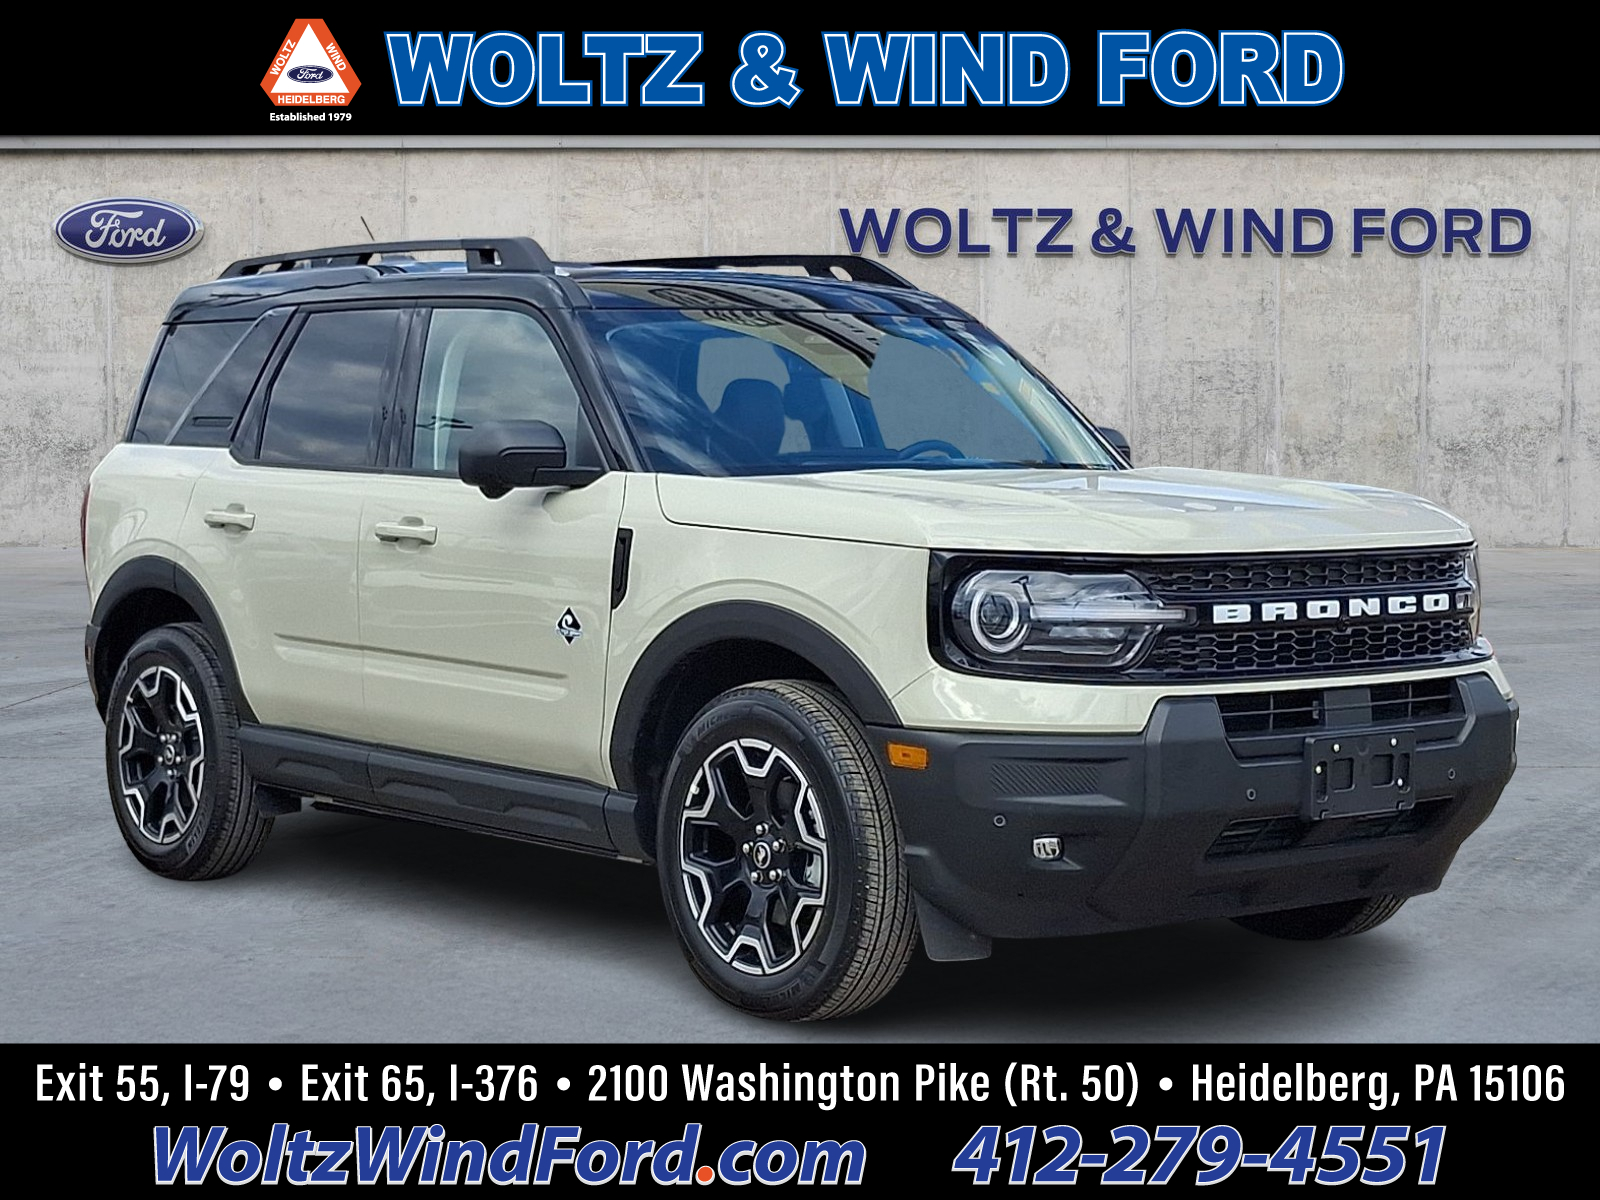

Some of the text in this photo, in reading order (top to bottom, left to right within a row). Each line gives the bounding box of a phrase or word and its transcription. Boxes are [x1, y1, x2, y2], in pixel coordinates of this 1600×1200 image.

[85, 210, 166, 248] Ford
[840, 207, 1533, 255] WOLTZ & WIND FORD
[1212, 593, 1450, 624] BRONCO
